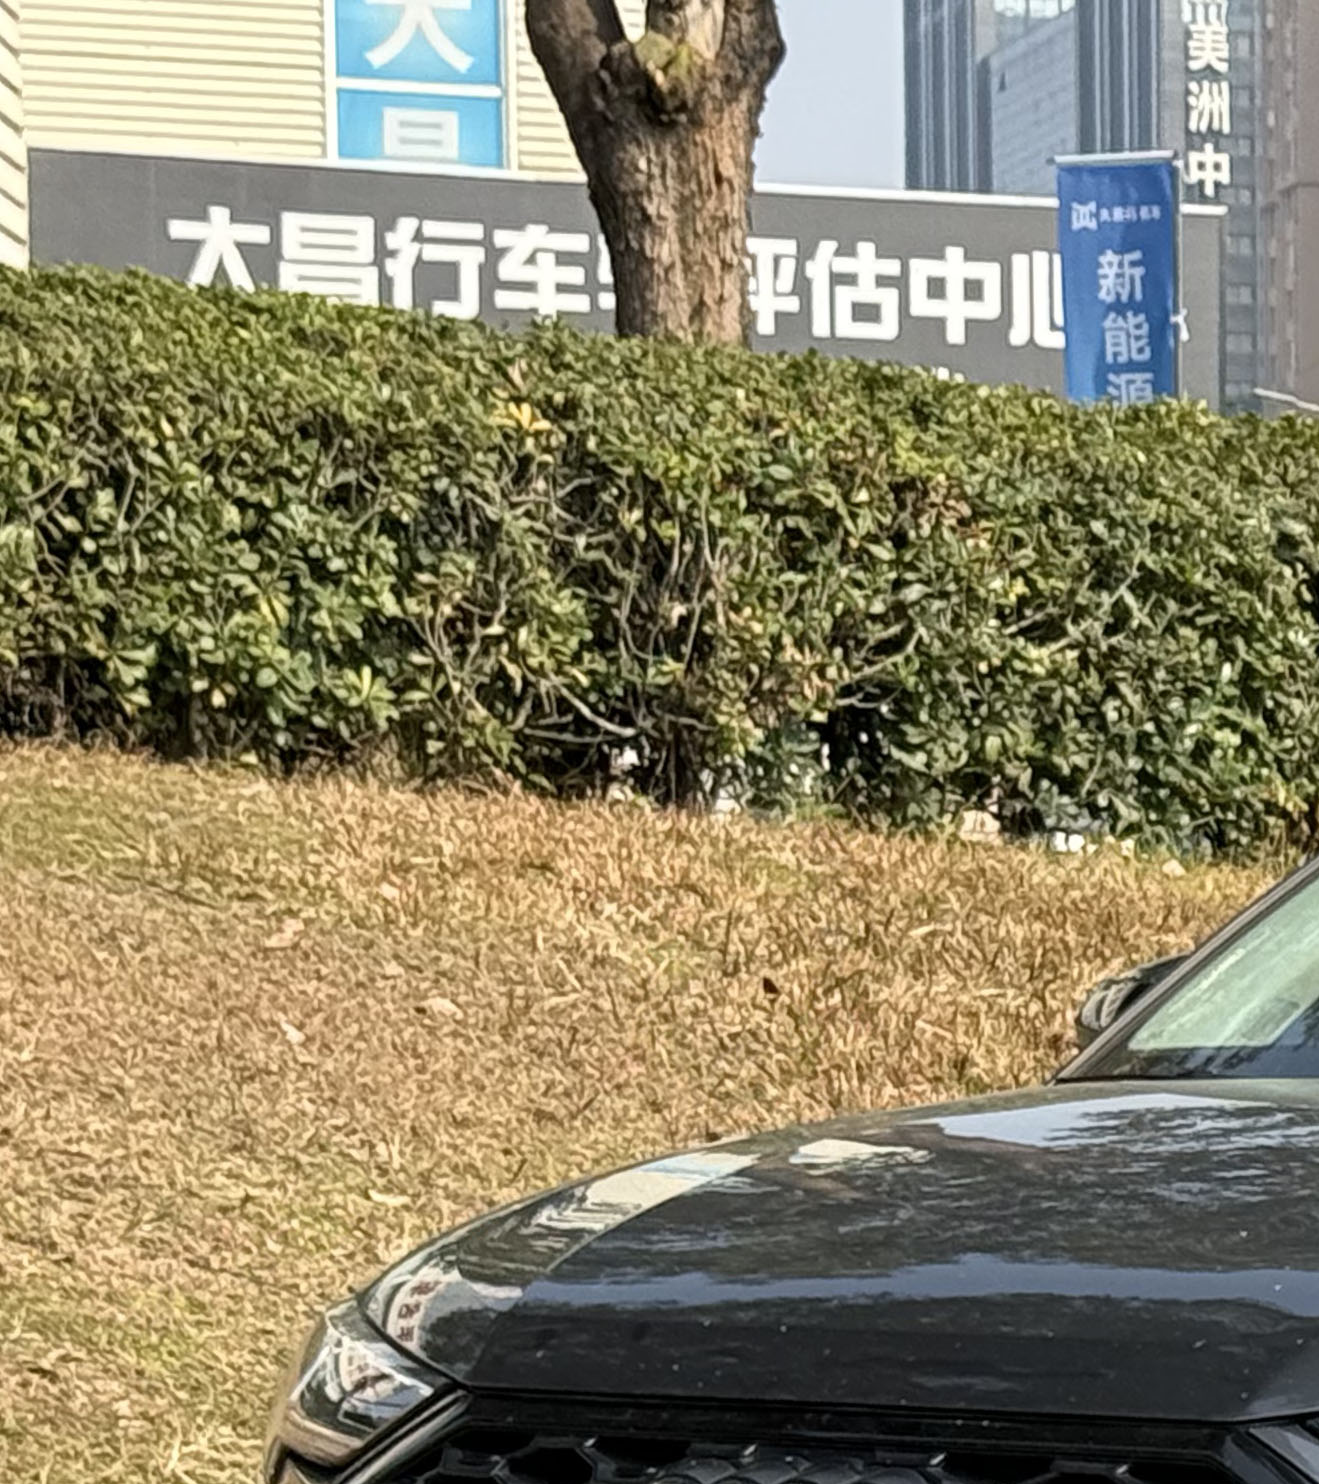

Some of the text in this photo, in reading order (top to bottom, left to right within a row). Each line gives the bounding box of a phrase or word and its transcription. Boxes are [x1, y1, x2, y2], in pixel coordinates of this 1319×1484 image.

[166, 205, 1067, 349] 大昌行车评估中心
